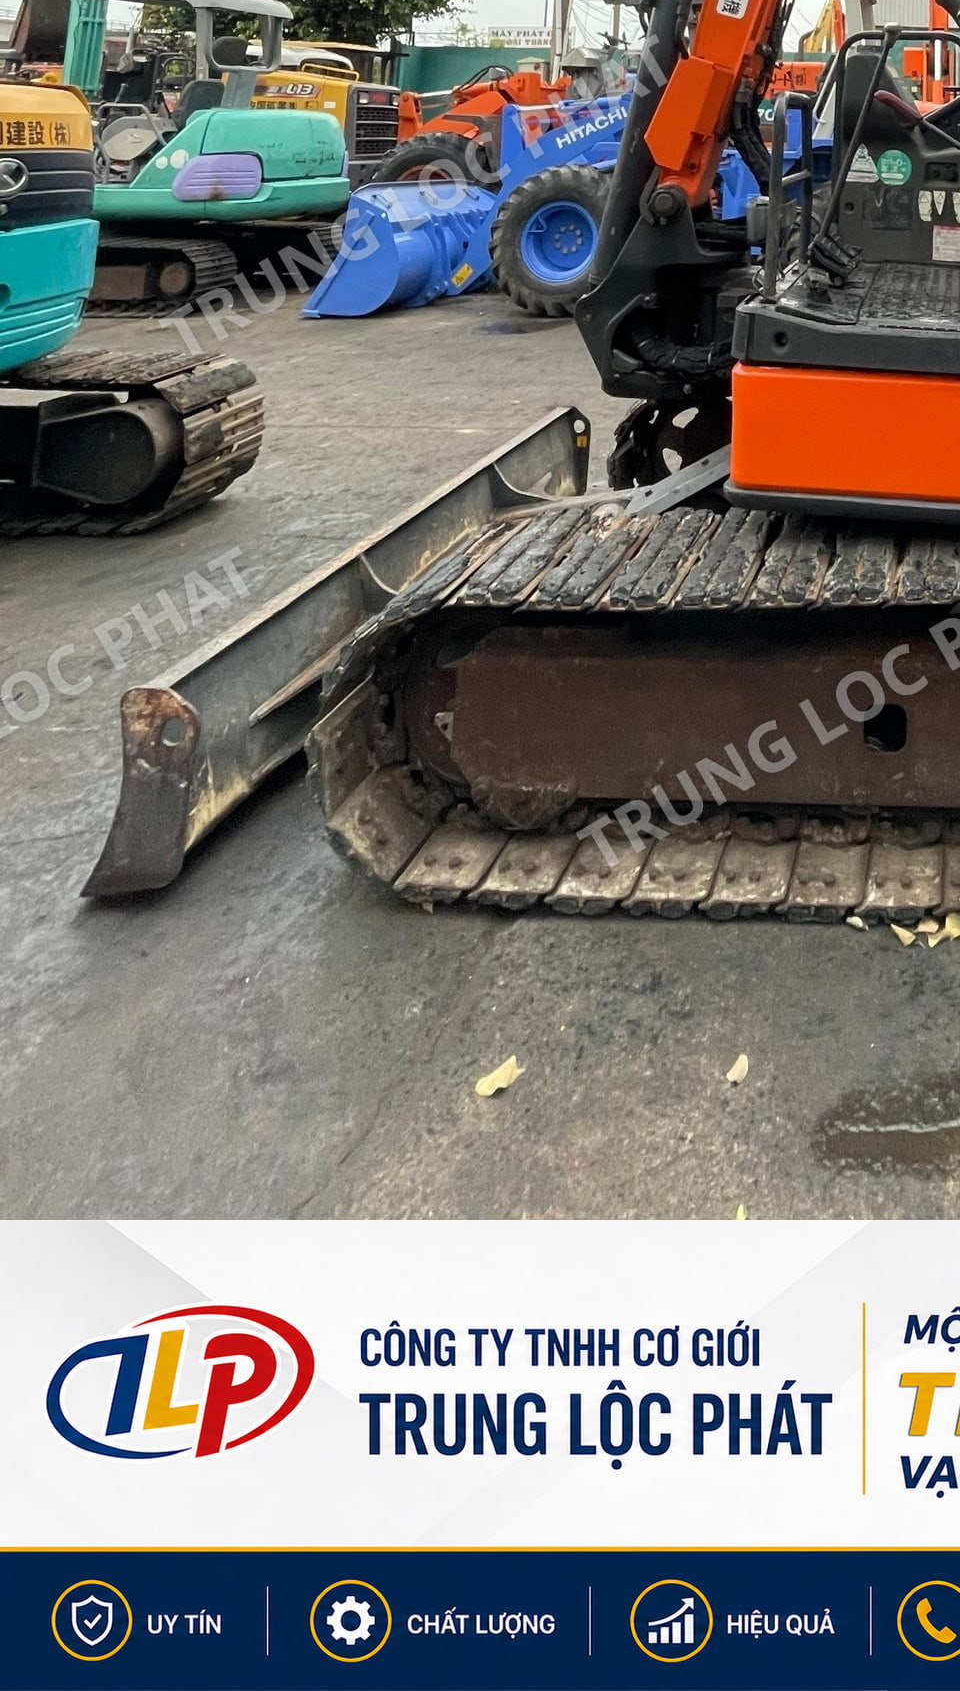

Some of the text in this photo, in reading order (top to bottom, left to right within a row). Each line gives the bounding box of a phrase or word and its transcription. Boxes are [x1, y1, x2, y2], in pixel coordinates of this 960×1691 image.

[0, 121, 71, 146] 建設(株)
[556, 106, 628, 150] HITACHI
